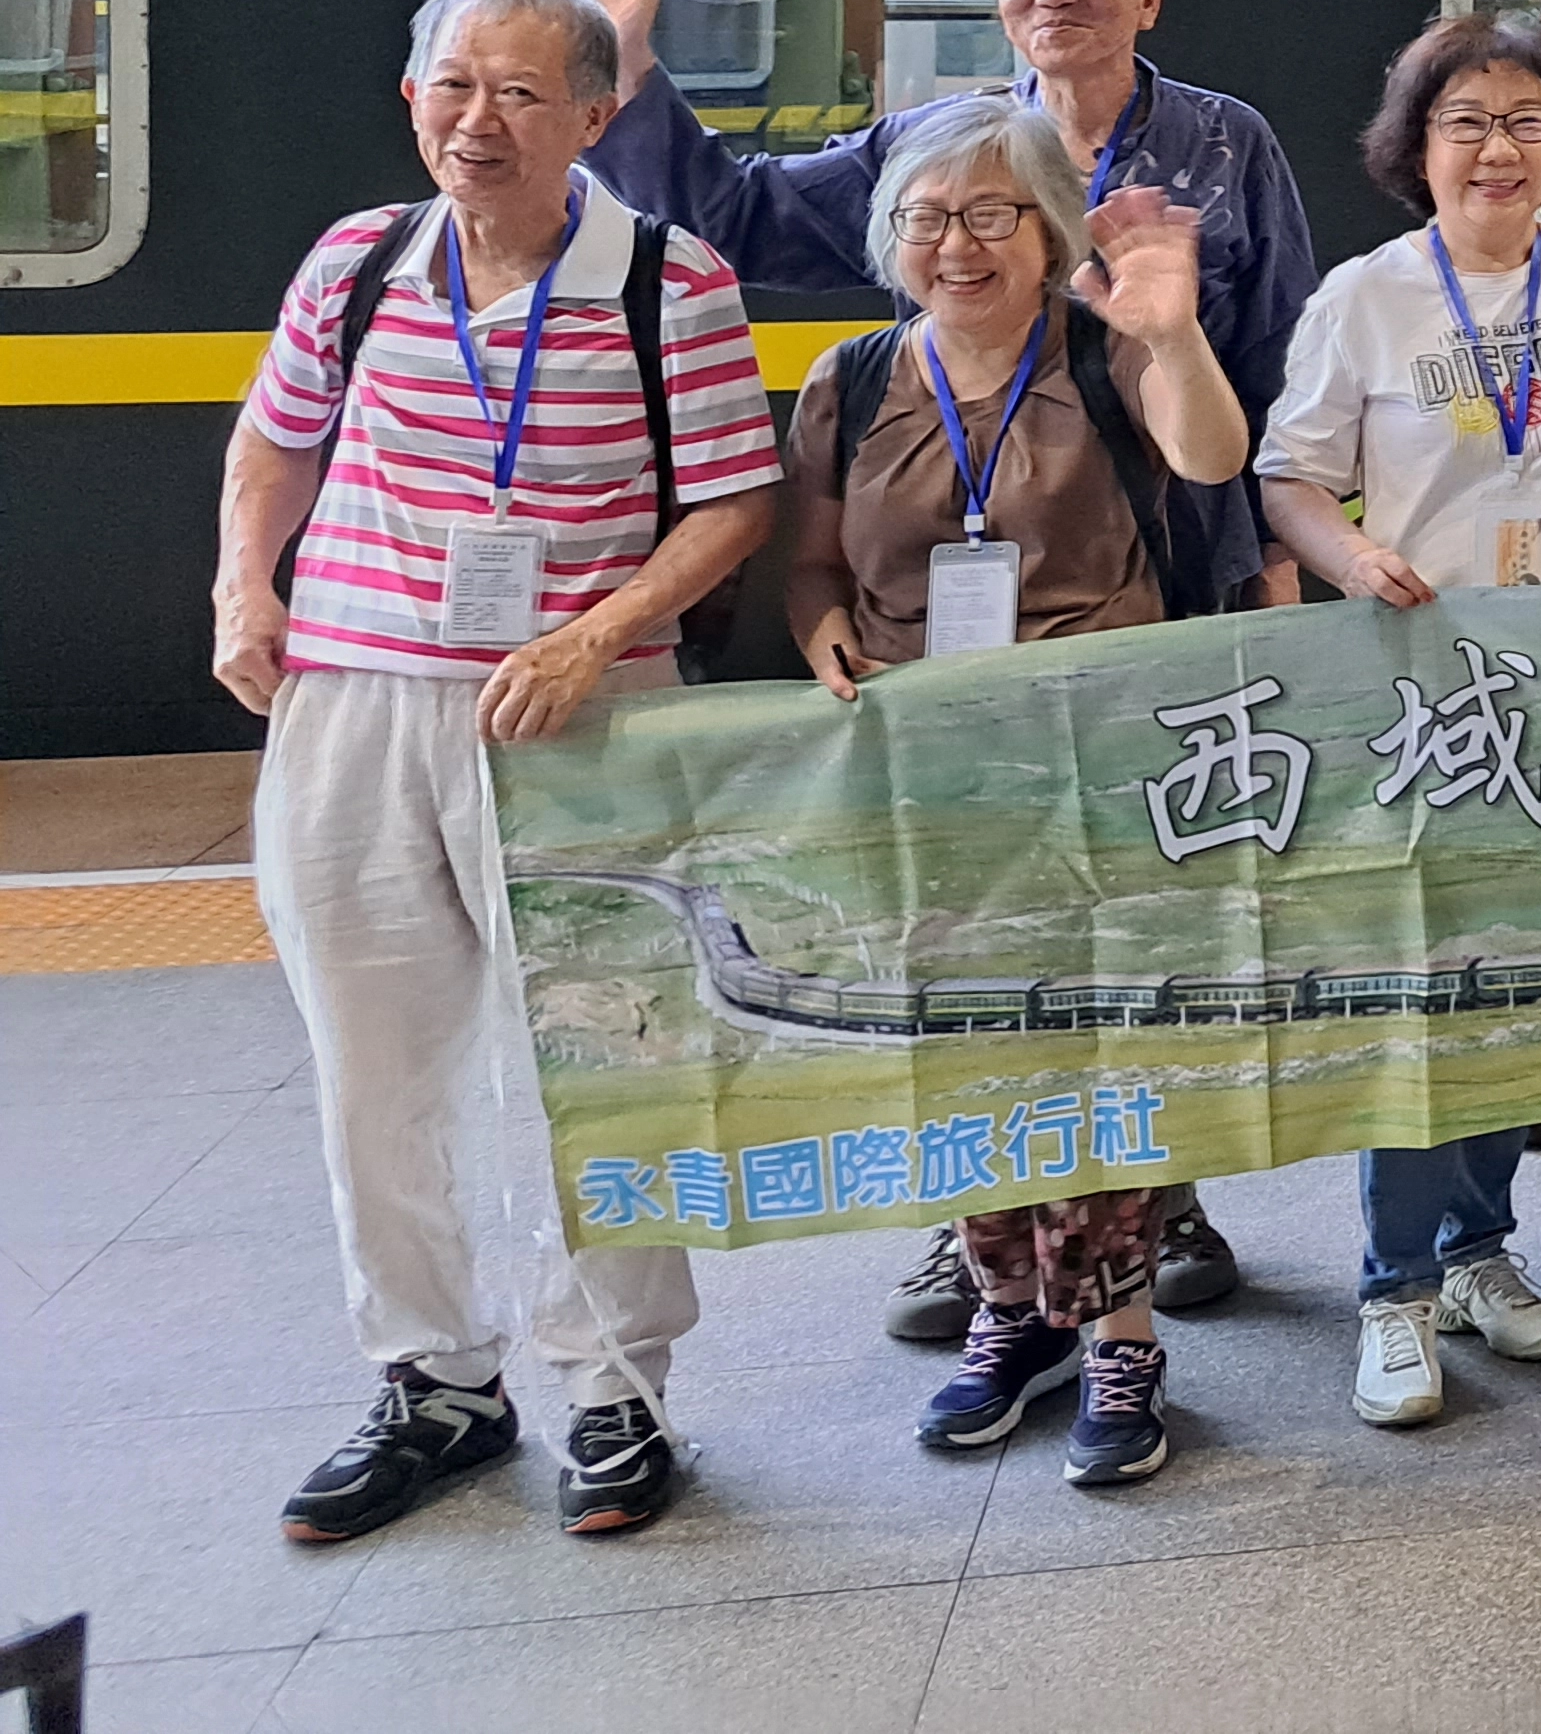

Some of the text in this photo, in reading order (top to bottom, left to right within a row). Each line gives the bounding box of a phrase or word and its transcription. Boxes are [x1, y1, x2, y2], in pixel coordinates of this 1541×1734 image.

[577, 1084, 1169, 1231] 永青國際旅行社
